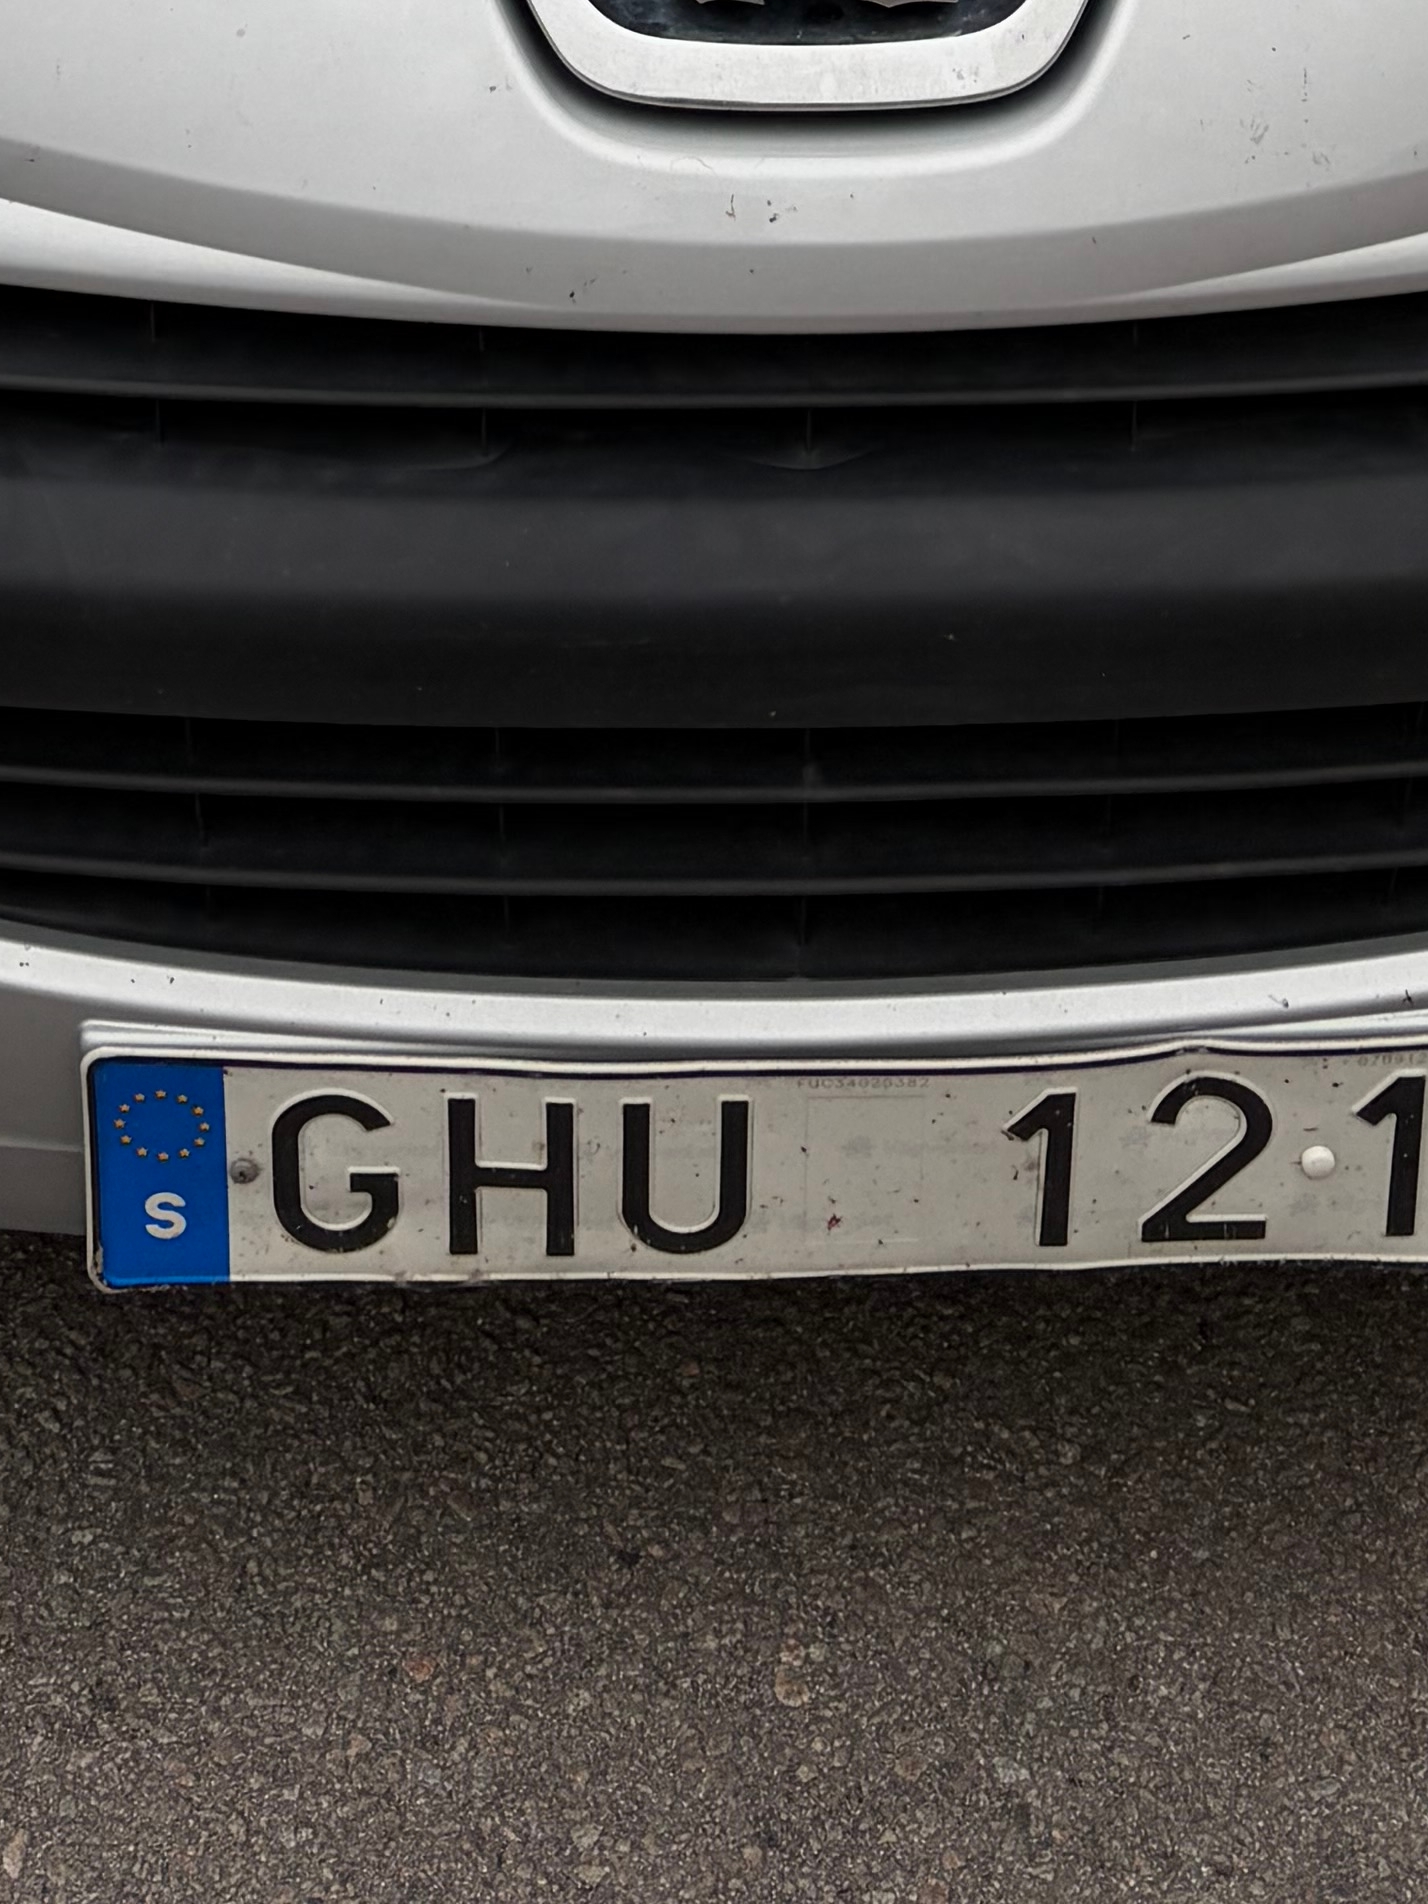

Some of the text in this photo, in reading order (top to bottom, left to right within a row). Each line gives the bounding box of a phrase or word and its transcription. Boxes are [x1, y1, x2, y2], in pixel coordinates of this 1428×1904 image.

[145, 1192, 186, 1239] S
[271, 1073, 1427, 1255] GHU 121
